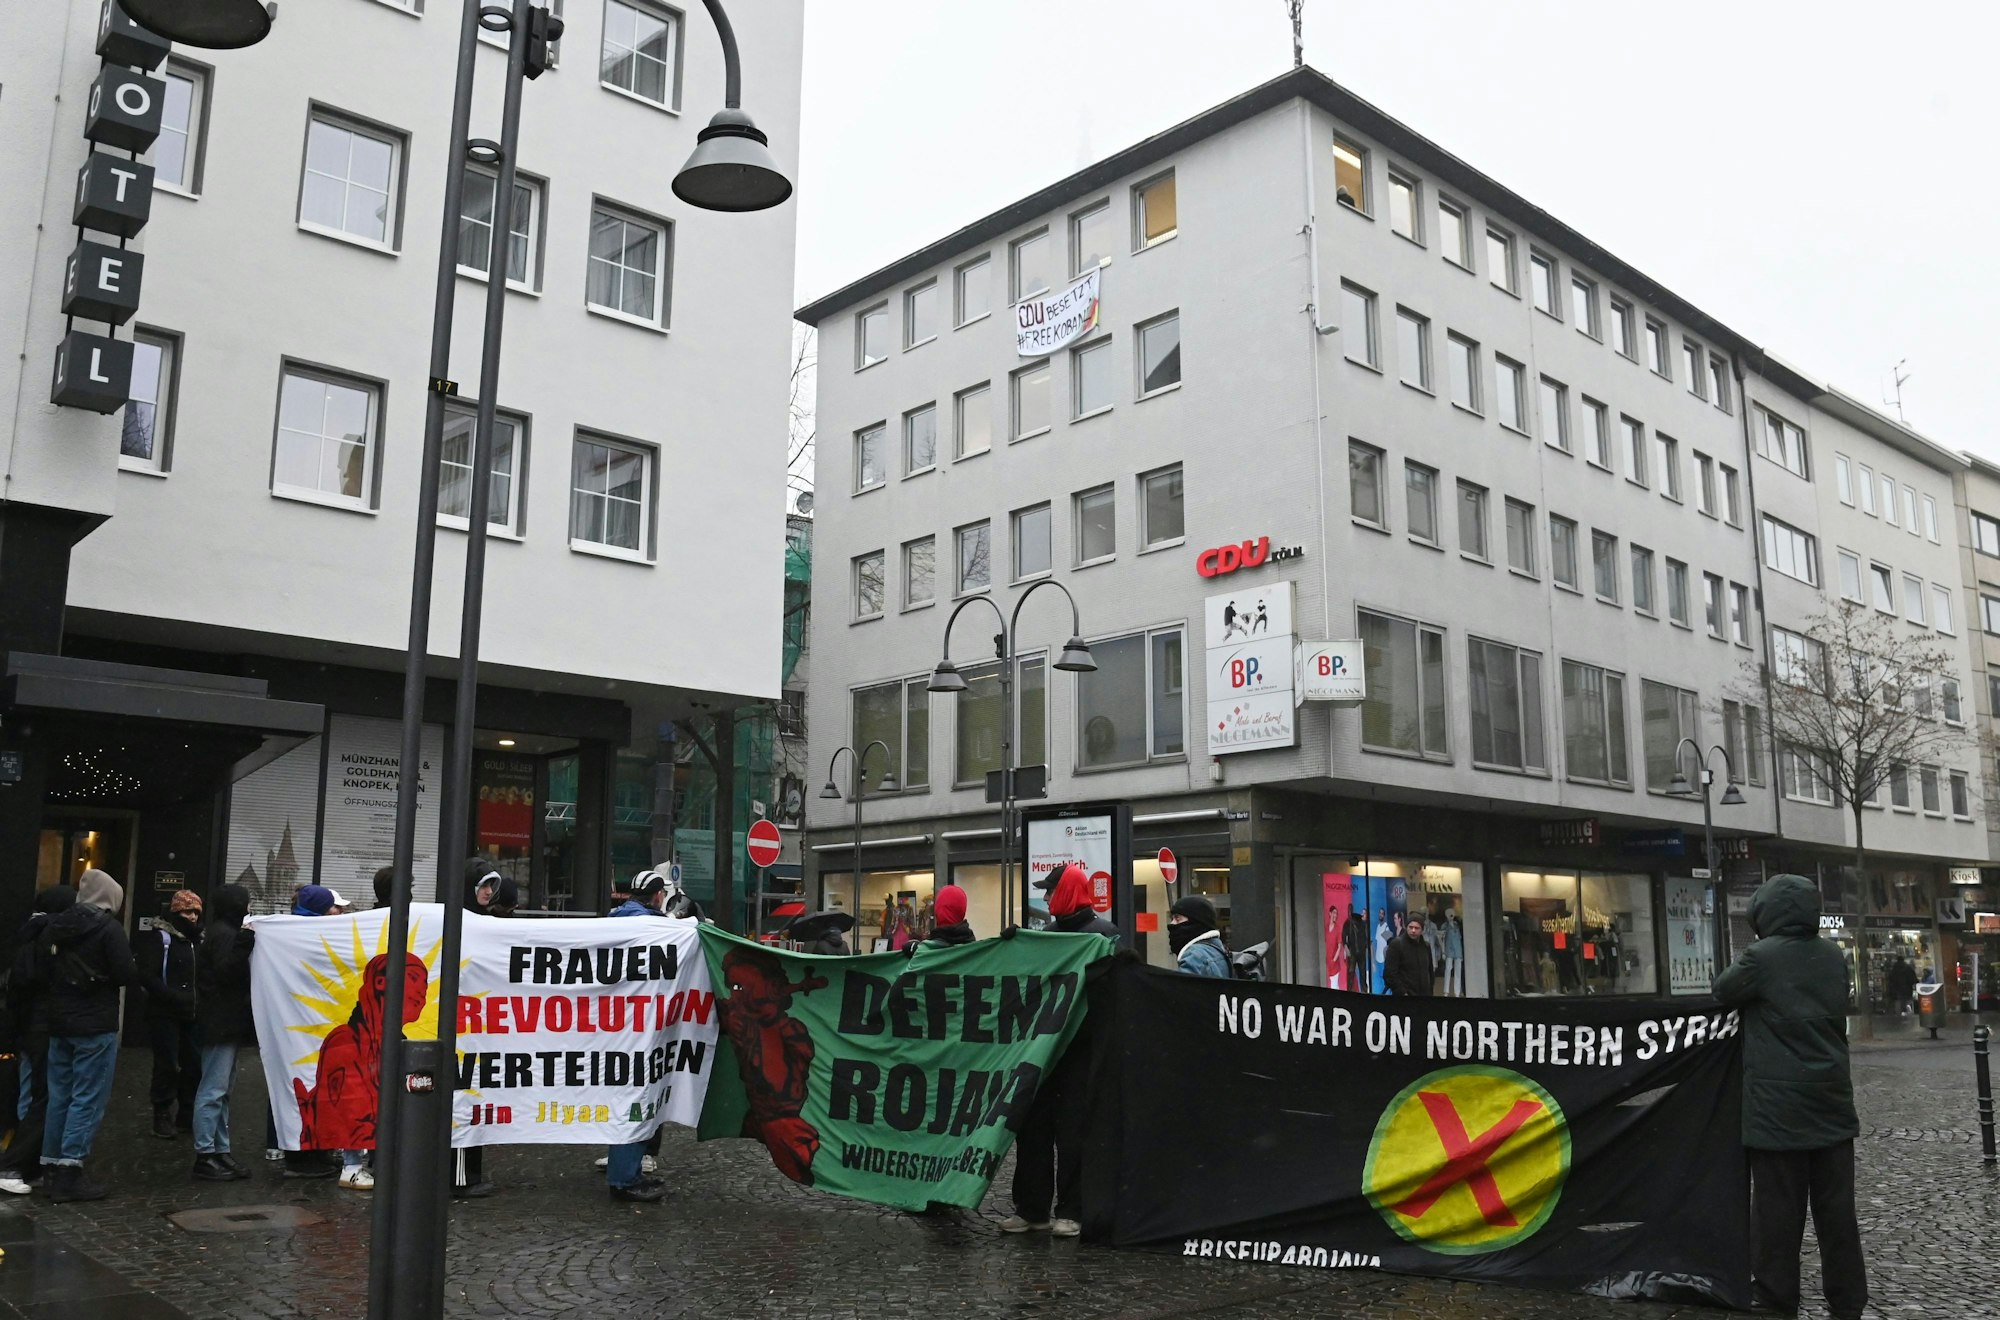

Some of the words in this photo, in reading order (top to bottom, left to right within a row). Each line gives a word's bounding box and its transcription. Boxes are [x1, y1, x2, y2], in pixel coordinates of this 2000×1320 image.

[90, 17, 152, 384] OTEL
[1019, 302, 1045, 328] CDU
[1046, 275, 1093, 321] BESETZT
[437, 379, 452, 392] 17
[1196, 536, 1269, 578] CDU
[1272, 546, 1304, 563] KÖLN
[1264, 710, 1283, 725] Beruf
[1210, 725, 1290, 743] NIGGEMANN
[423, 761, 431, 770] &
[343, 779, 393, 791] KNOPEK,
[1951, 870, 1979, 880] Kiosk
[1835, 916, 1844, 928] 54
[509, 944, 678, 984] FRAUEN
[456, 988, 715, 1034] REVOLUTION
[838, 970, 1079, 1044] DEFEND
[1218, 993, 1262, 1039] NO
[1276, 1003, 1353, 1048] WAR
[1366, 1011, 1411, 1056] ON
[1426, 1019, 1623, 1067] NORTHERN
[1636, 1008, 1740, 1061] SYRIA
[453, 1039, 706, 1089] VERTEIDIGEN
[470, 1104, 512, 1125] Jin
[535, 1101, 609, 1125] Jiyan
